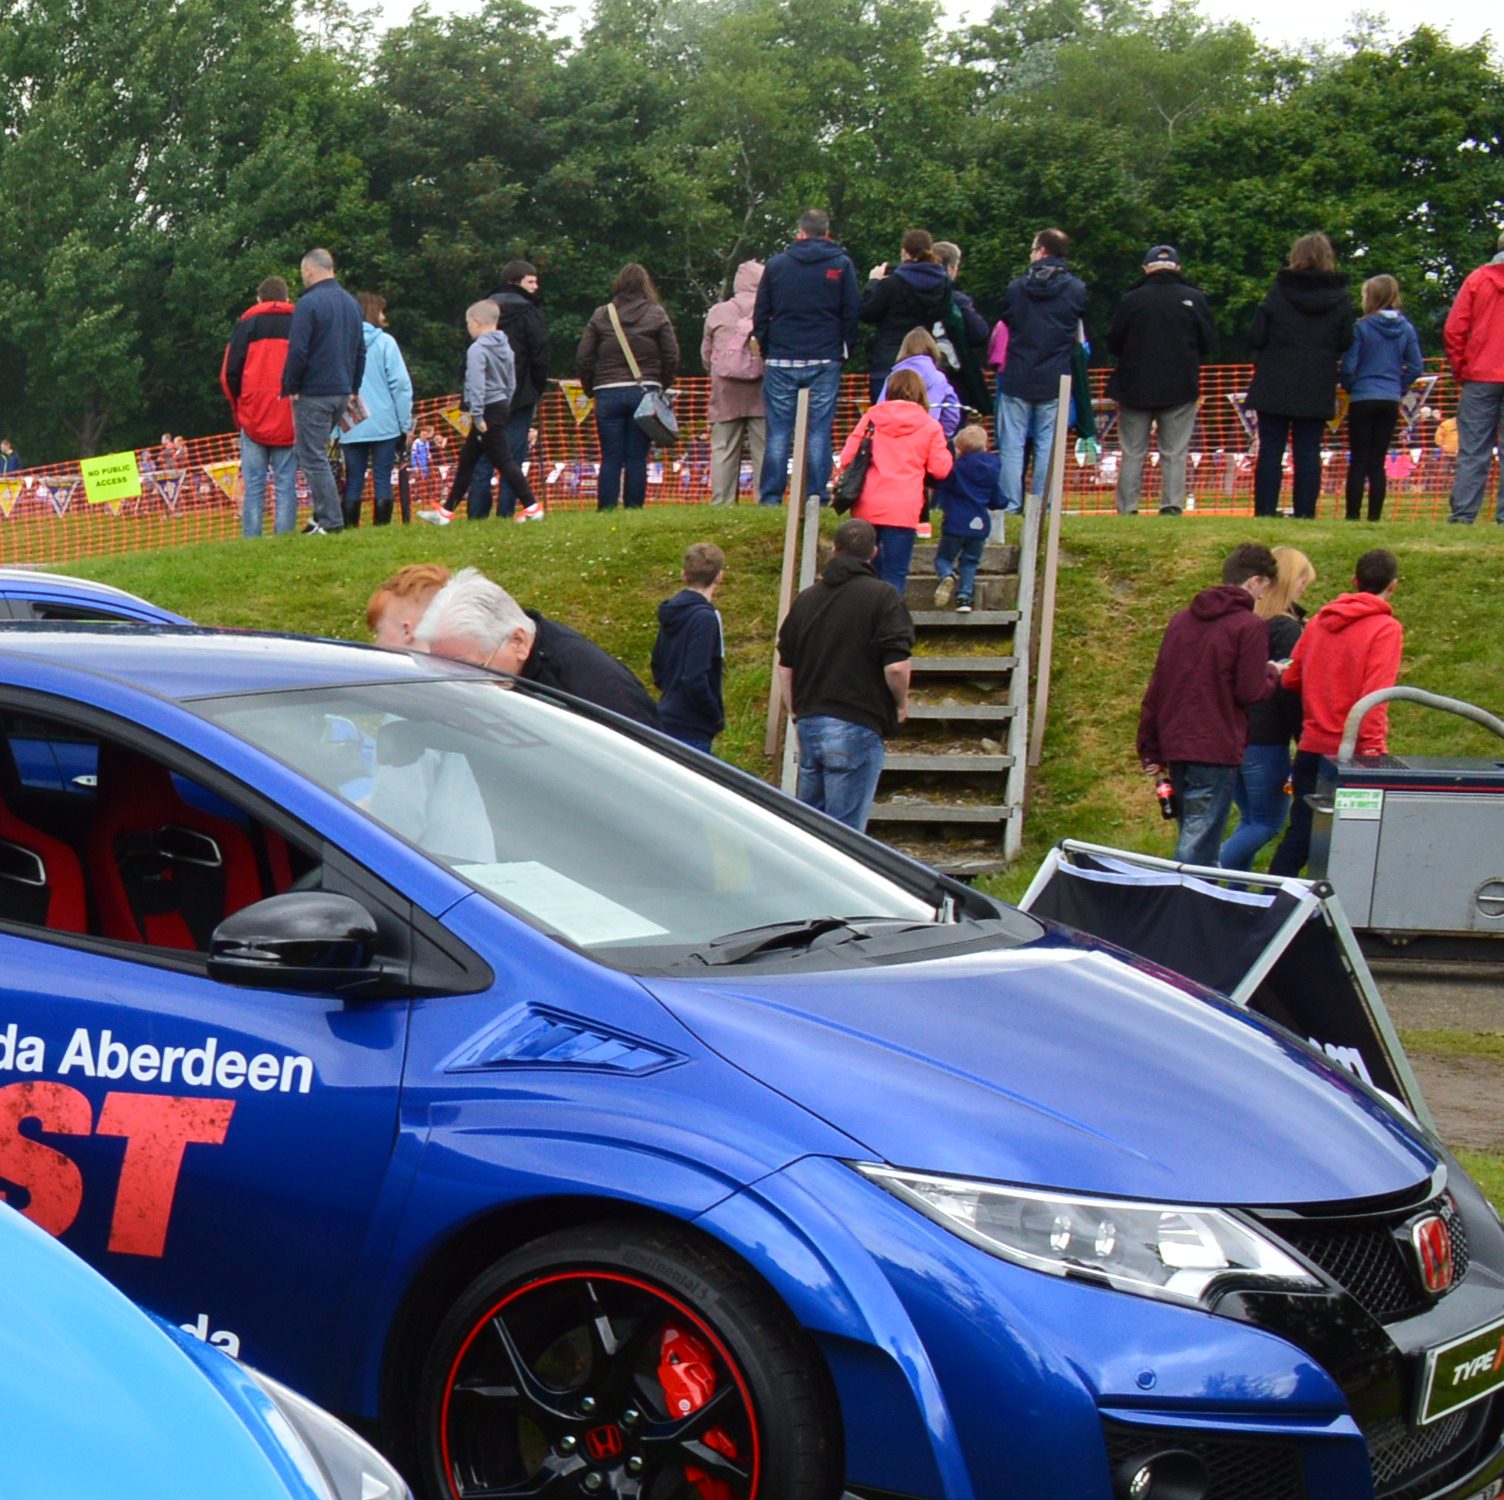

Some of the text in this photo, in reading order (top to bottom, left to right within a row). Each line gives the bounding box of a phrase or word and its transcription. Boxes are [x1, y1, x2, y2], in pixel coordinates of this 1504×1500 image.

[102, 464, 131, 473] PUBLIC
[96, 476, 128, 486] ACCESS
[58, 1028, 314, 1094] Aberdeen
[1452, 1348, 1497, 1386] TYPE
